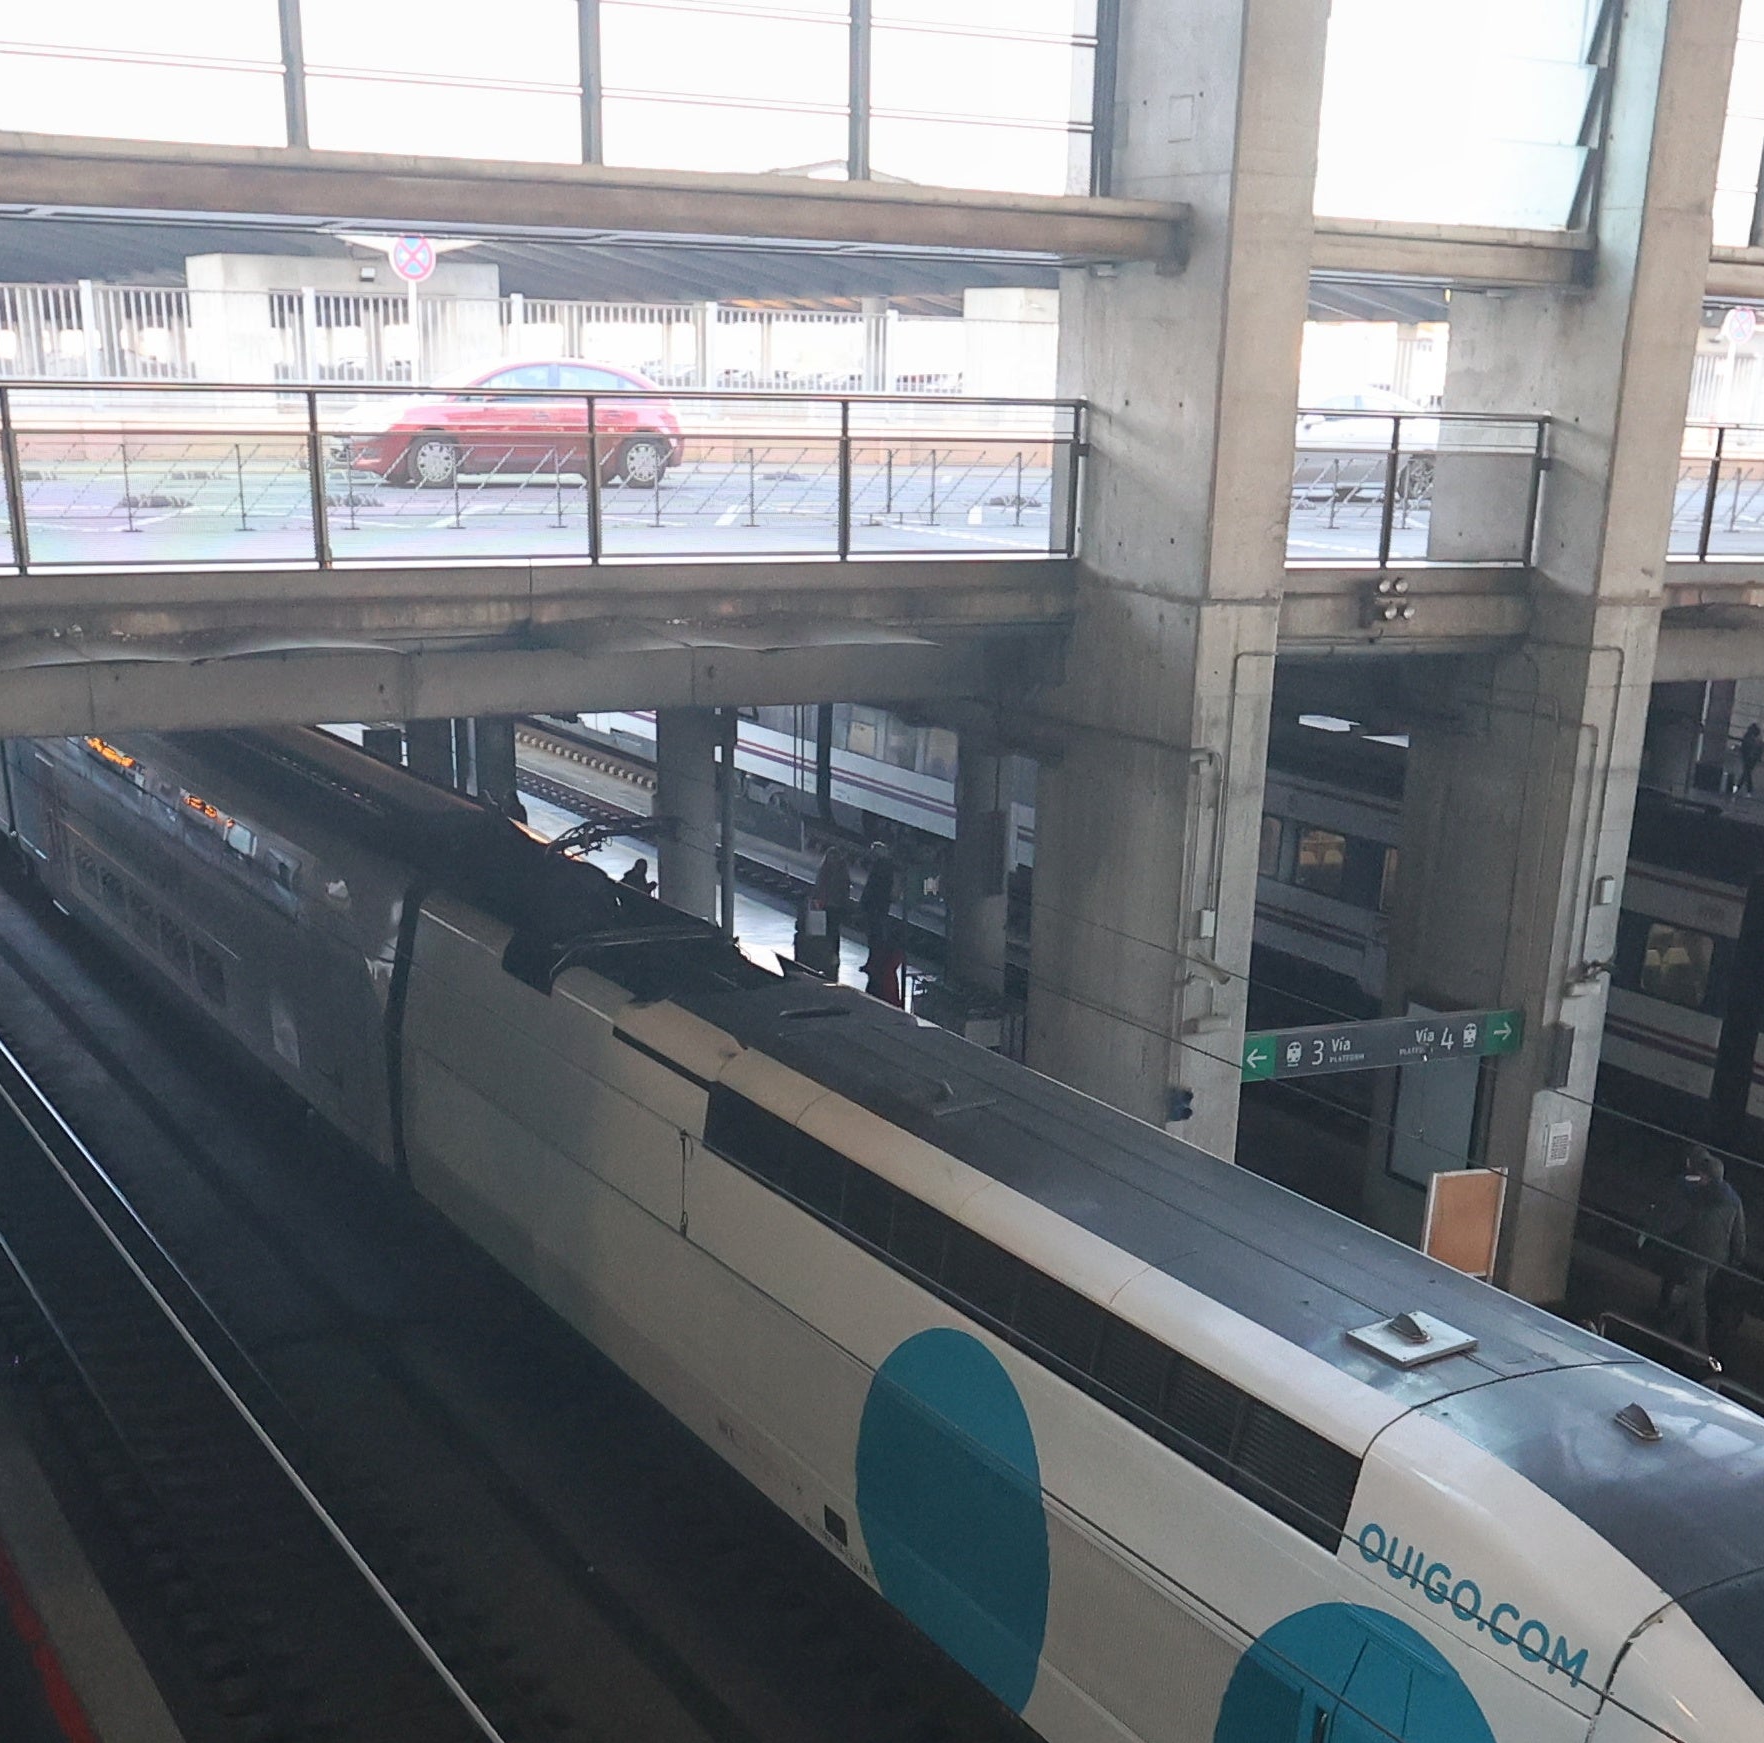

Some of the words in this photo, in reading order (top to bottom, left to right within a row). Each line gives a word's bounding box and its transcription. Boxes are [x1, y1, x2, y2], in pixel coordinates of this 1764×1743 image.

[1311, 1039, 1325, 1066] 3
[1331, 1036, 1351, 1053] Vía
[1415, 1027, 1435, 1044] Vía
[1440, 1026, 1455, 1051] 4
[1358, 1523, 1589, 1688] OUIGO.COM
